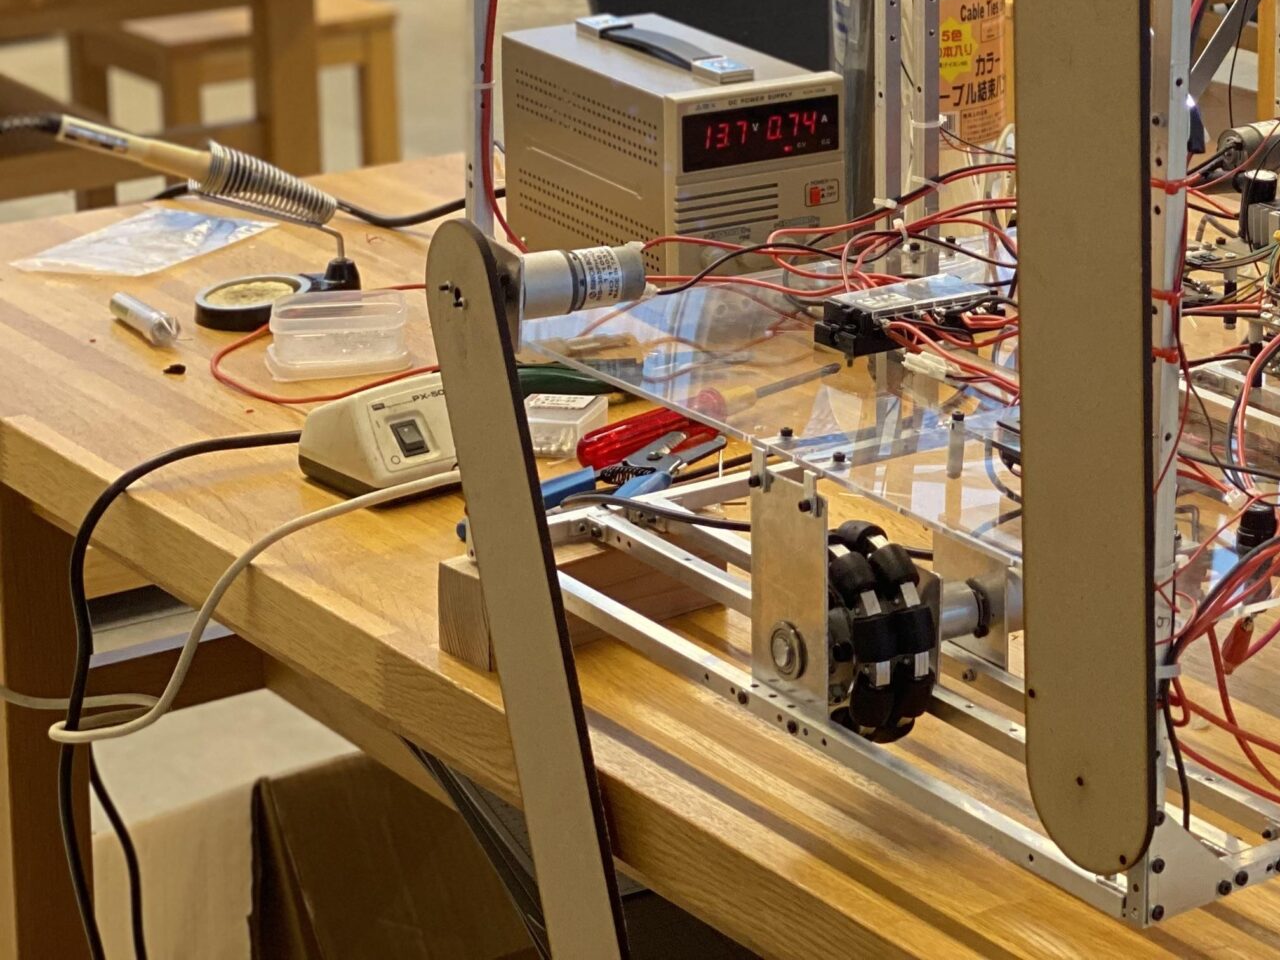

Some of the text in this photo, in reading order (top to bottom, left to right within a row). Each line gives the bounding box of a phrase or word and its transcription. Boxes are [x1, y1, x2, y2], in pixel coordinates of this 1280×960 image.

[960, 0, 999, 22] Cable Ties
[975, 51, 1000, 77] カラー
[741, 96, 765, 104] POWER
[768, 92, 793, 101] SUPPLY
[820, 114, 828, 123] A
